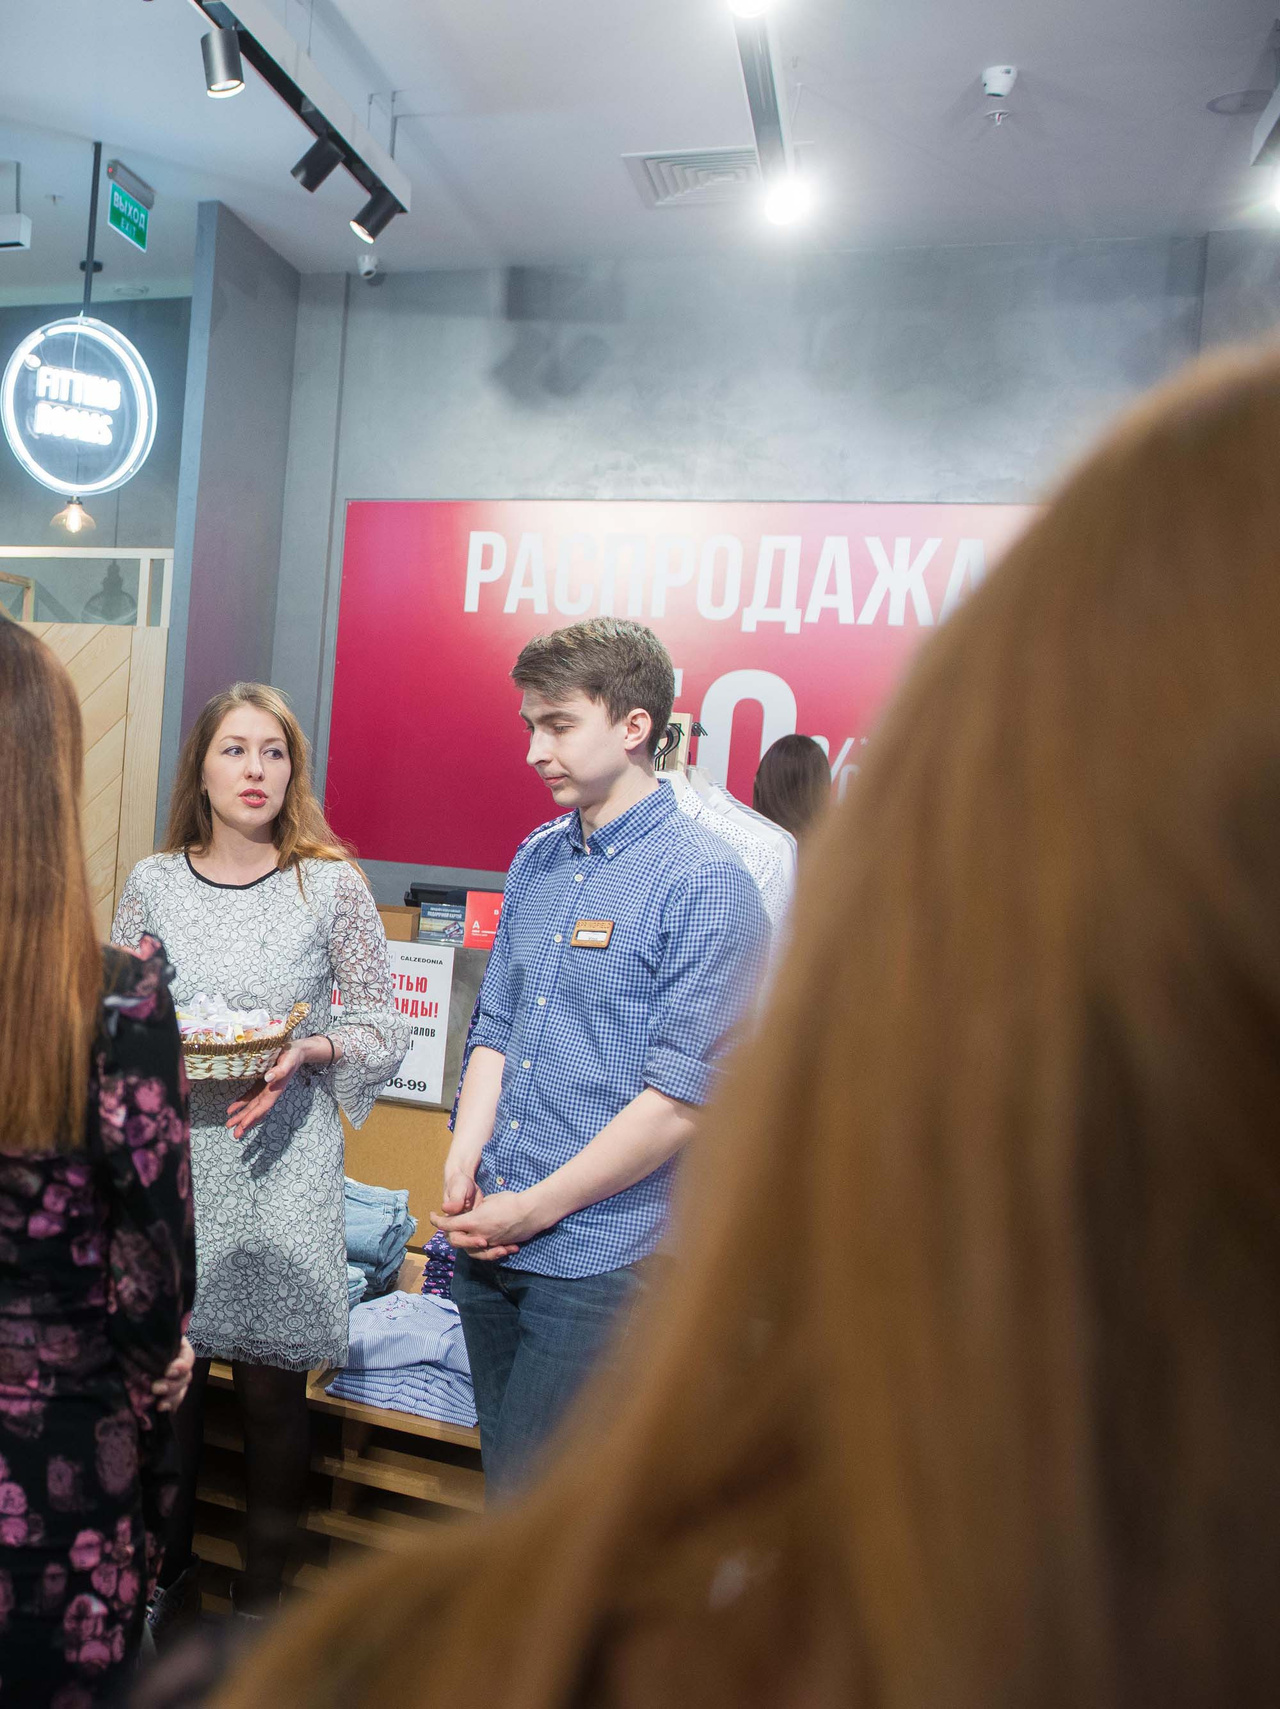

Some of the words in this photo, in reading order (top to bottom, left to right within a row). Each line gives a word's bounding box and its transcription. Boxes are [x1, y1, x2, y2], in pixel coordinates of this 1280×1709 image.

[113, 191, 146, 230] ВЫХОД
[464, 531, 987, 634] РАСПРОДАЖА
[400, 955, 444, 966] CALZEDONIA
